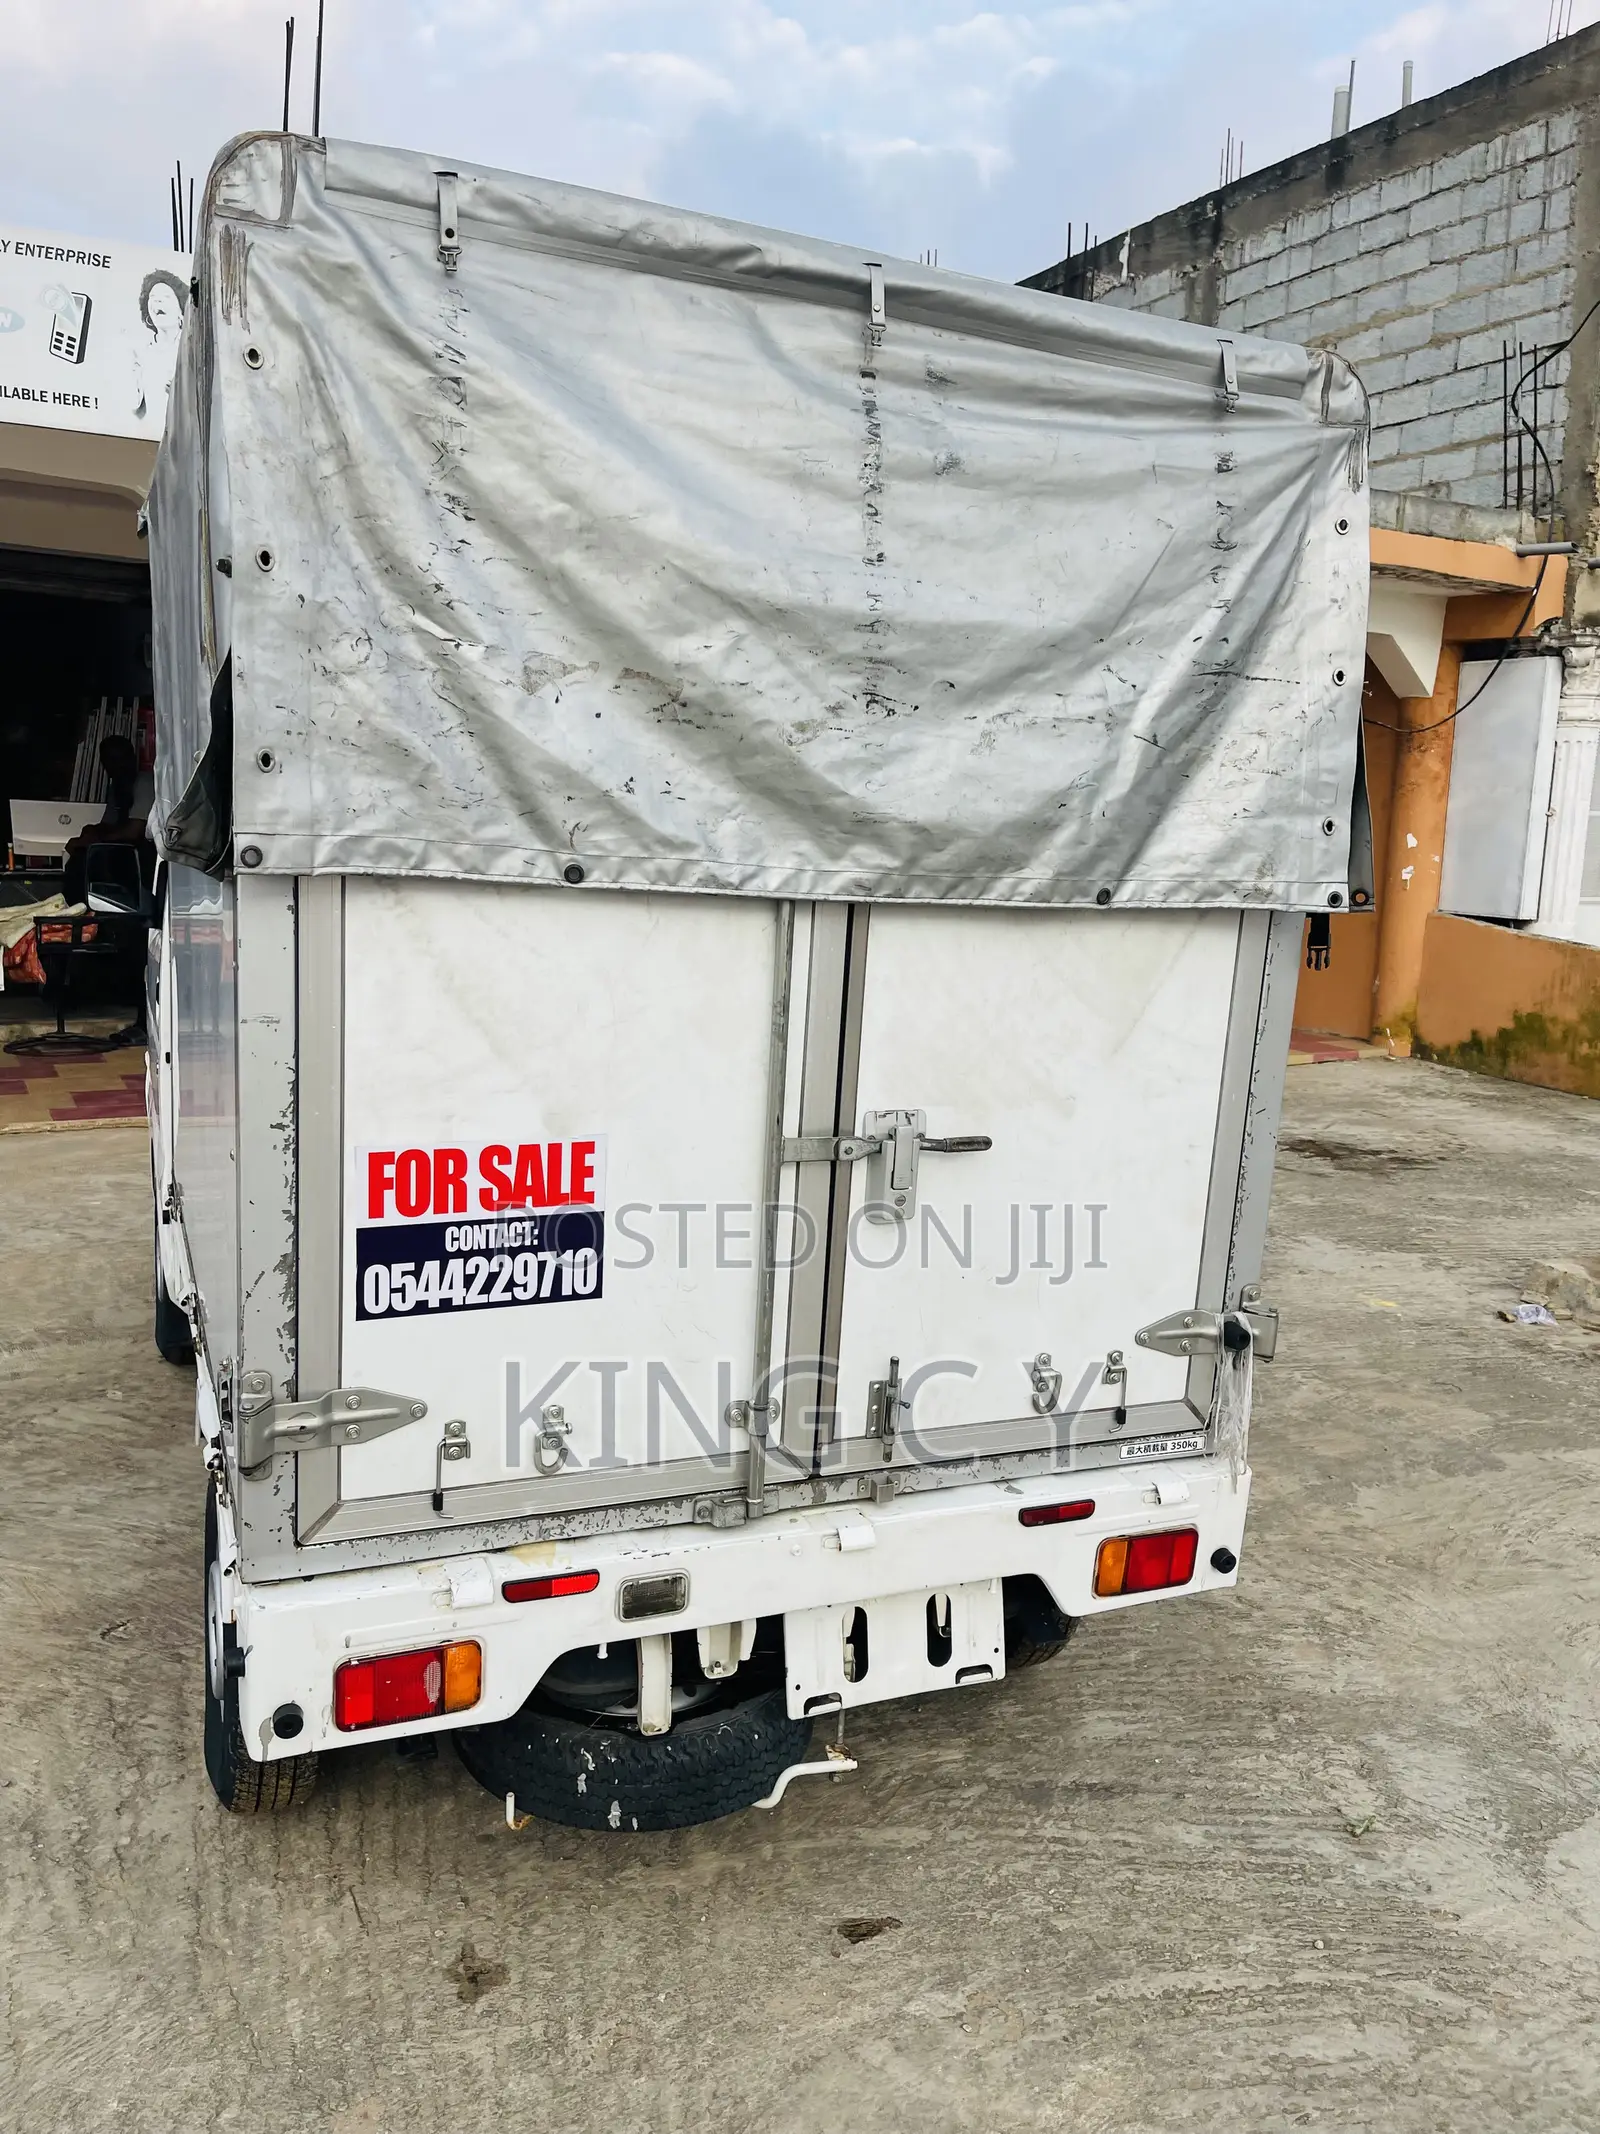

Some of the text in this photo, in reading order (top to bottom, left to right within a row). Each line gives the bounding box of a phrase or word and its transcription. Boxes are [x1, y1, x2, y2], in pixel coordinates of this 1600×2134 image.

[0, 239, 111, 268] Y ENTERPRISE
[52, 391, 91, 409] HERE
[94, 397, 99, 410] !
[368, 1141, 595, 1219] FOR SALE
[445, 1221, 538, 1252] CONTACT:
[363, 1247, 598, 1315] 0544229710
[1127, 1440, 1198, 1455] 最大積載量 350kg
